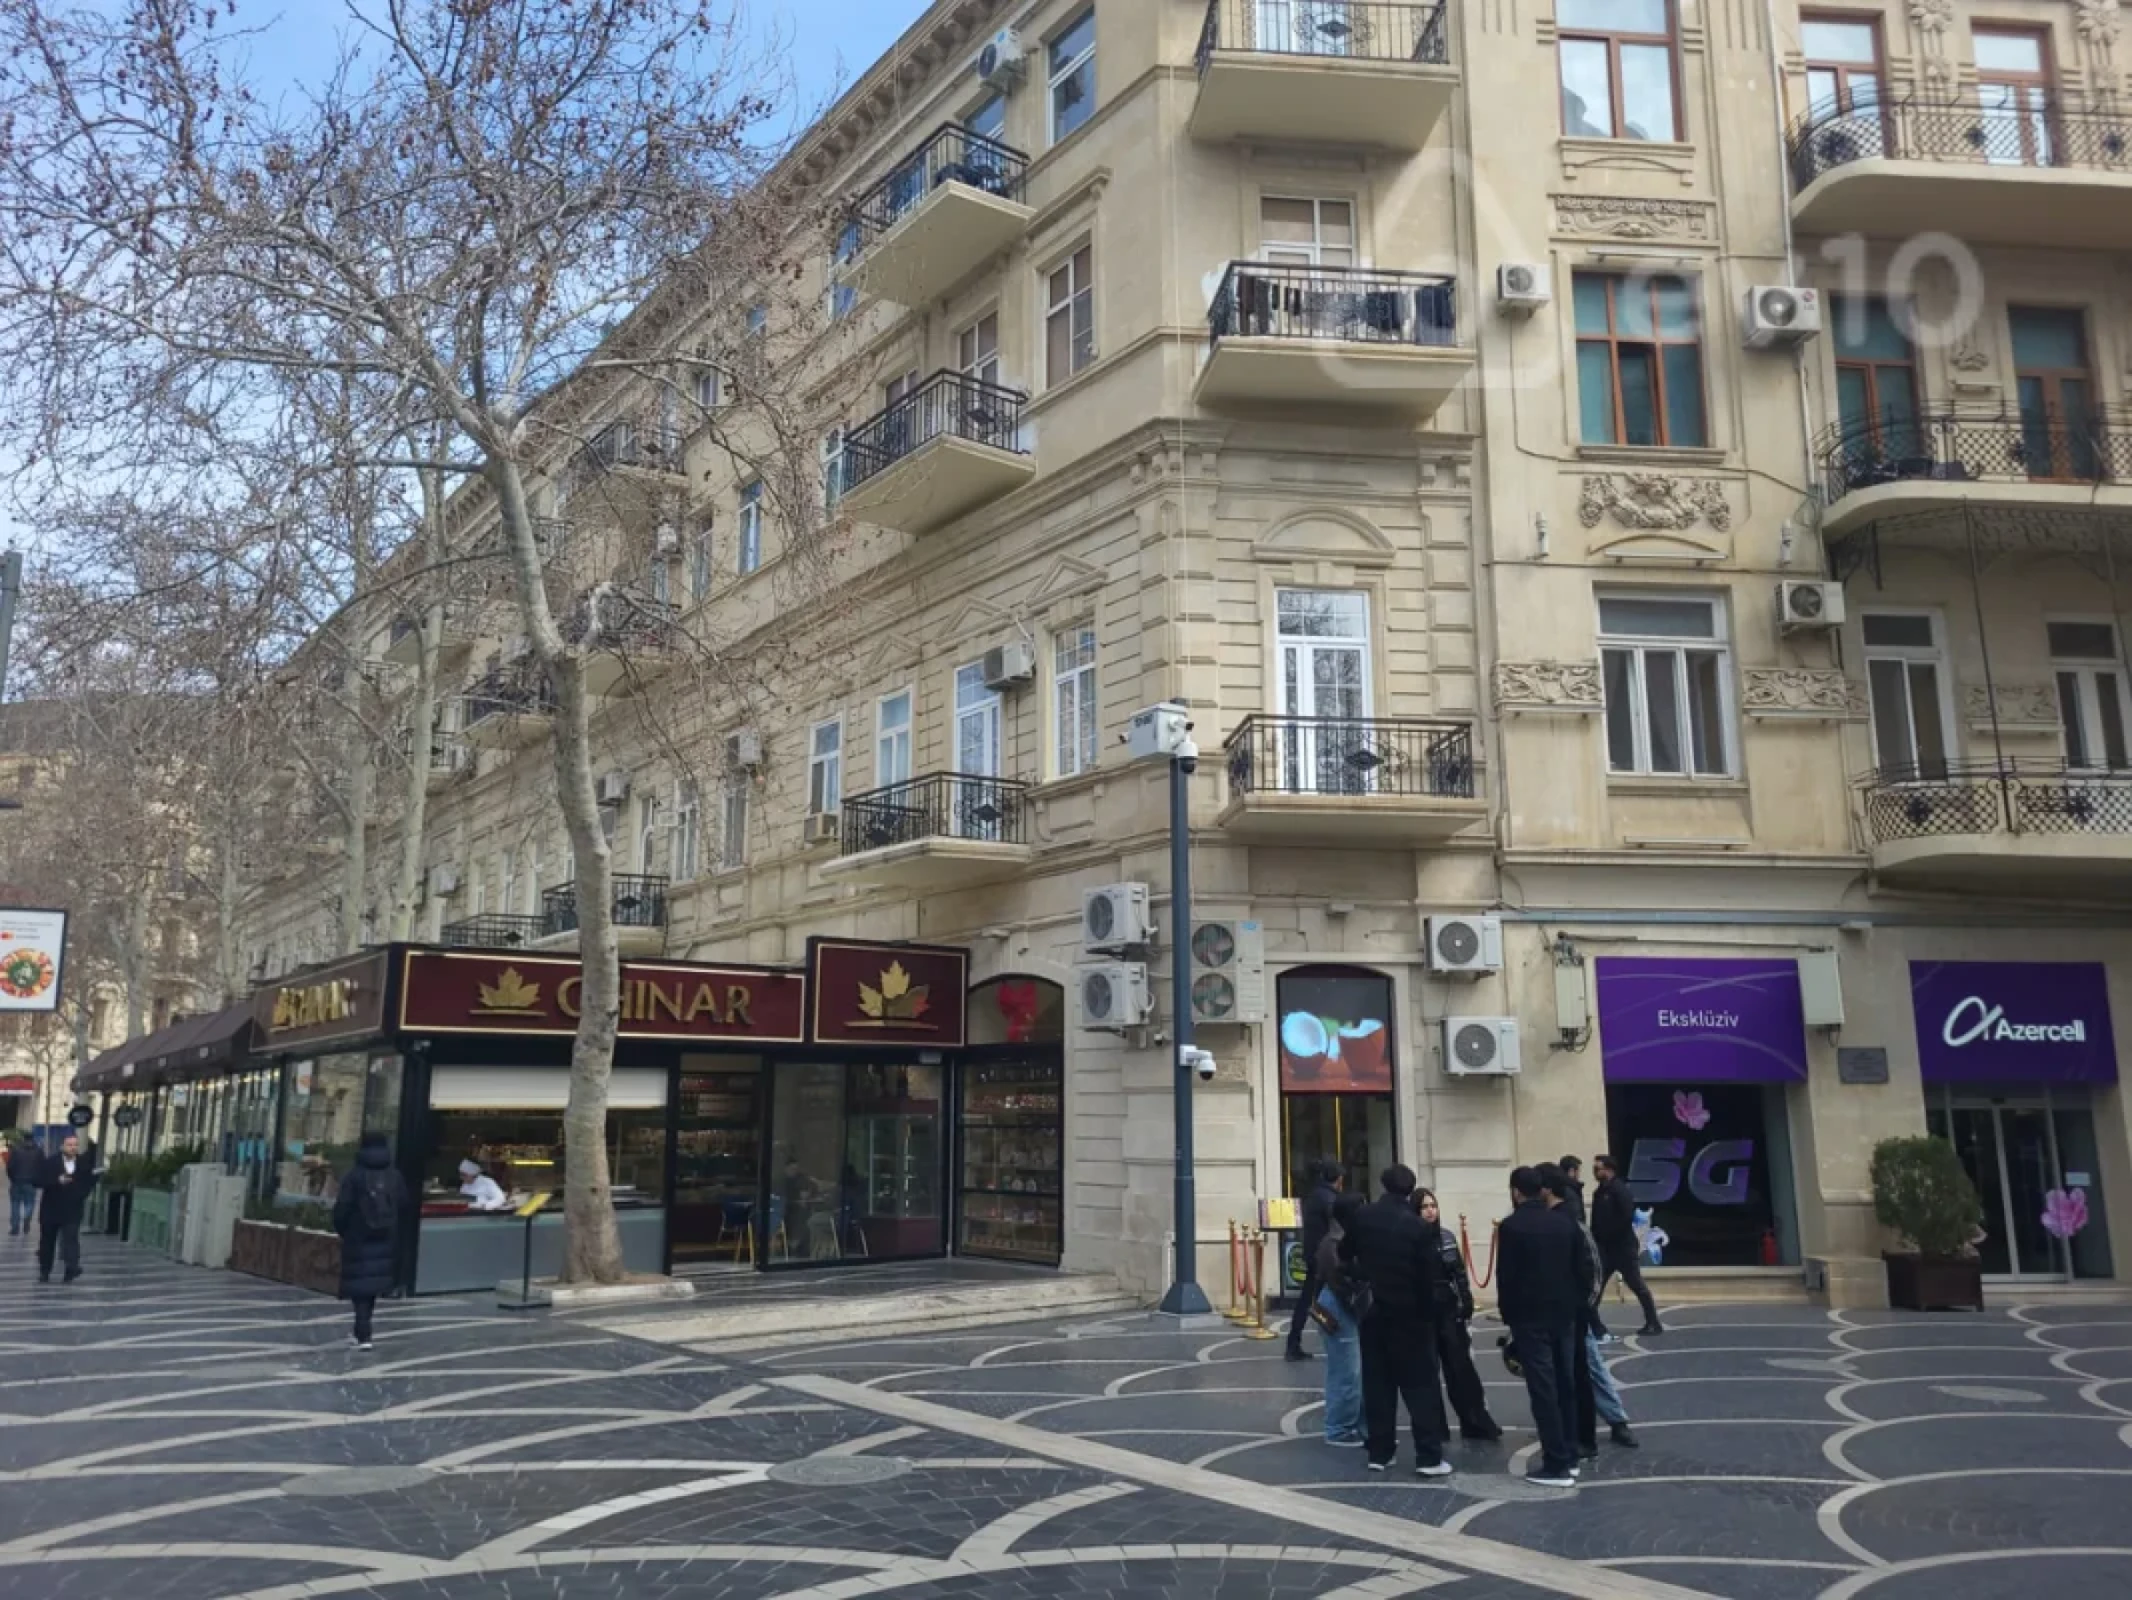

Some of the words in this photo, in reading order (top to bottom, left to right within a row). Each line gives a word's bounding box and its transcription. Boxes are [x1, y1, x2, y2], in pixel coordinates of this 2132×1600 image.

[1657, 1009, 1739, 1027] Eksklüziv
[1994, 1017, 2085, 1042] Azercell
[1625, 1138, 1754, 1205] 5G
